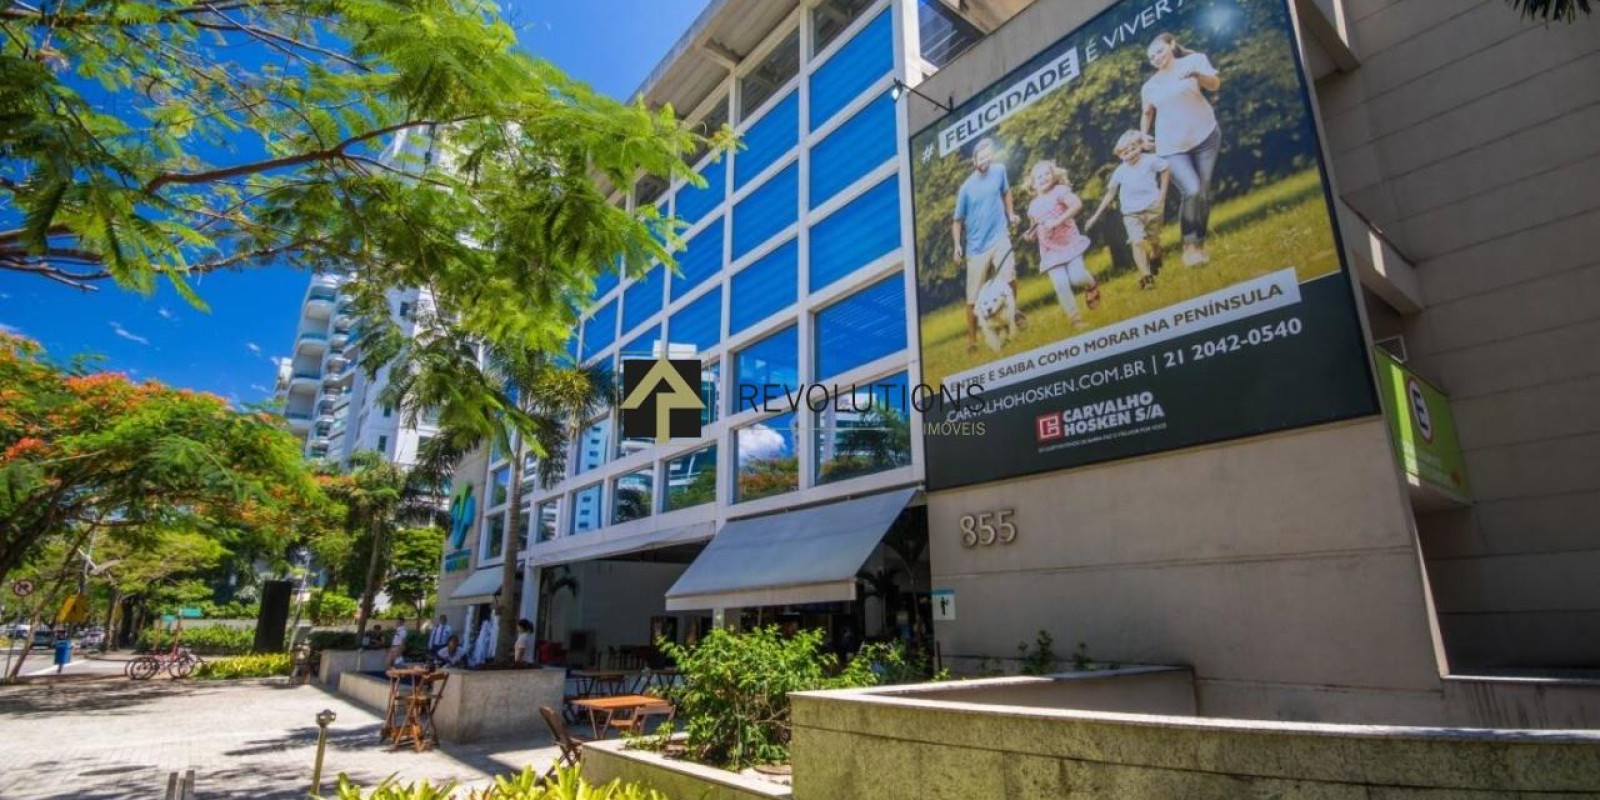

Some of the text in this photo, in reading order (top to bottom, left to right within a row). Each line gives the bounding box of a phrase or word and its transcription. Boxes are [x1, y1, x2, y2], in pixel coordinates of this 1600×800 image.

[944, 57, 1073, 150] FELICIDADE
[1085, 38, 1099, 63] É
[1102, 0, 1173, 48] VIVER
[946, 360, 1147, 423] CARVALHOHOSKEN.COM.BR
[1164, 349, 1185, 368] 21
[1192, 317, 1302, 362] 2042-0540
[950, 283, 1283, 392] ENTRE E SAIBA COMO MORAR NA PENÍNSULA
[1063, 391, 1154, 422] CARVALHO
[1064, 403, 1165, 437] HOSKEN S/A
[960, 508, 1017, 547] 855
